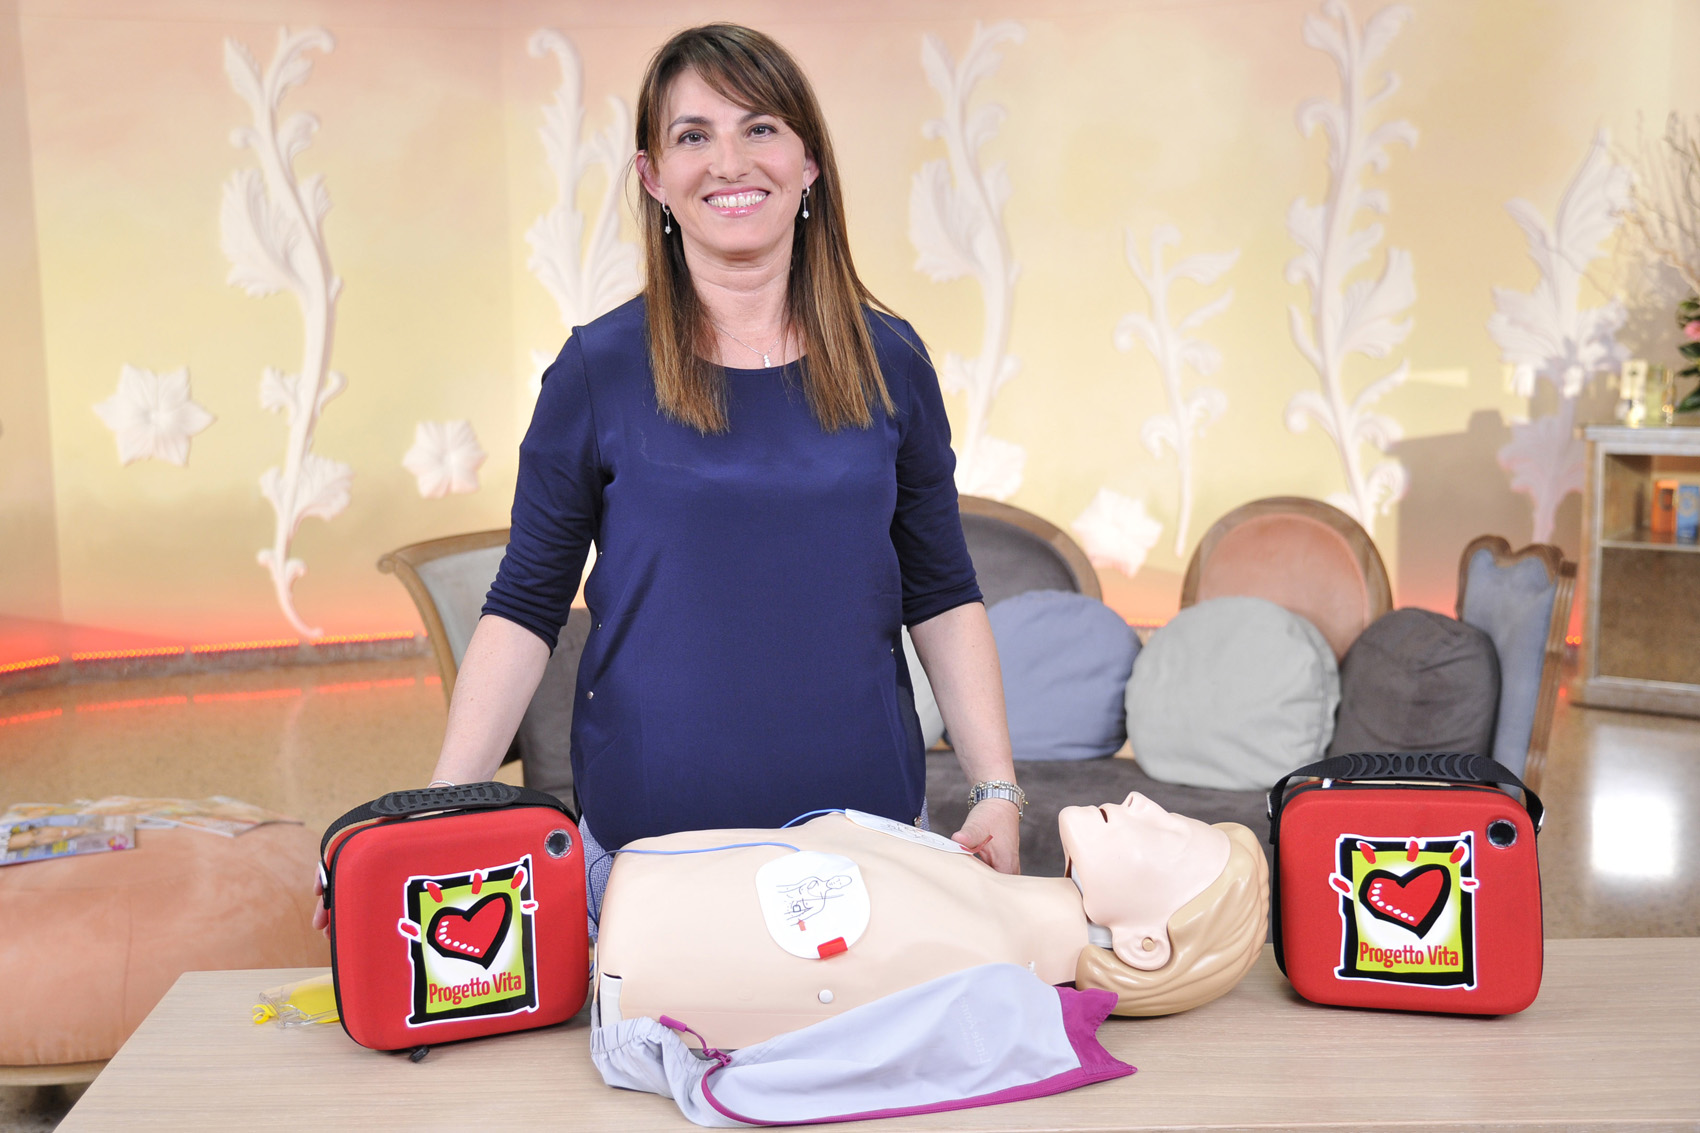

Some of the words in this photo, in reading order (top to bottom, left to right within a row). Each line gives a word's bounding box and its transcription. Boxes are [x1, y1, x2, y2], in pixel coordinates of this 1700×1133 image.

[1359, 942, 1424, 969] Progetto
[1427, 945, 1459, 966] Vita
[428, 977, 490, 1005] Progetto
[492, 971, 522, 993] Vita
